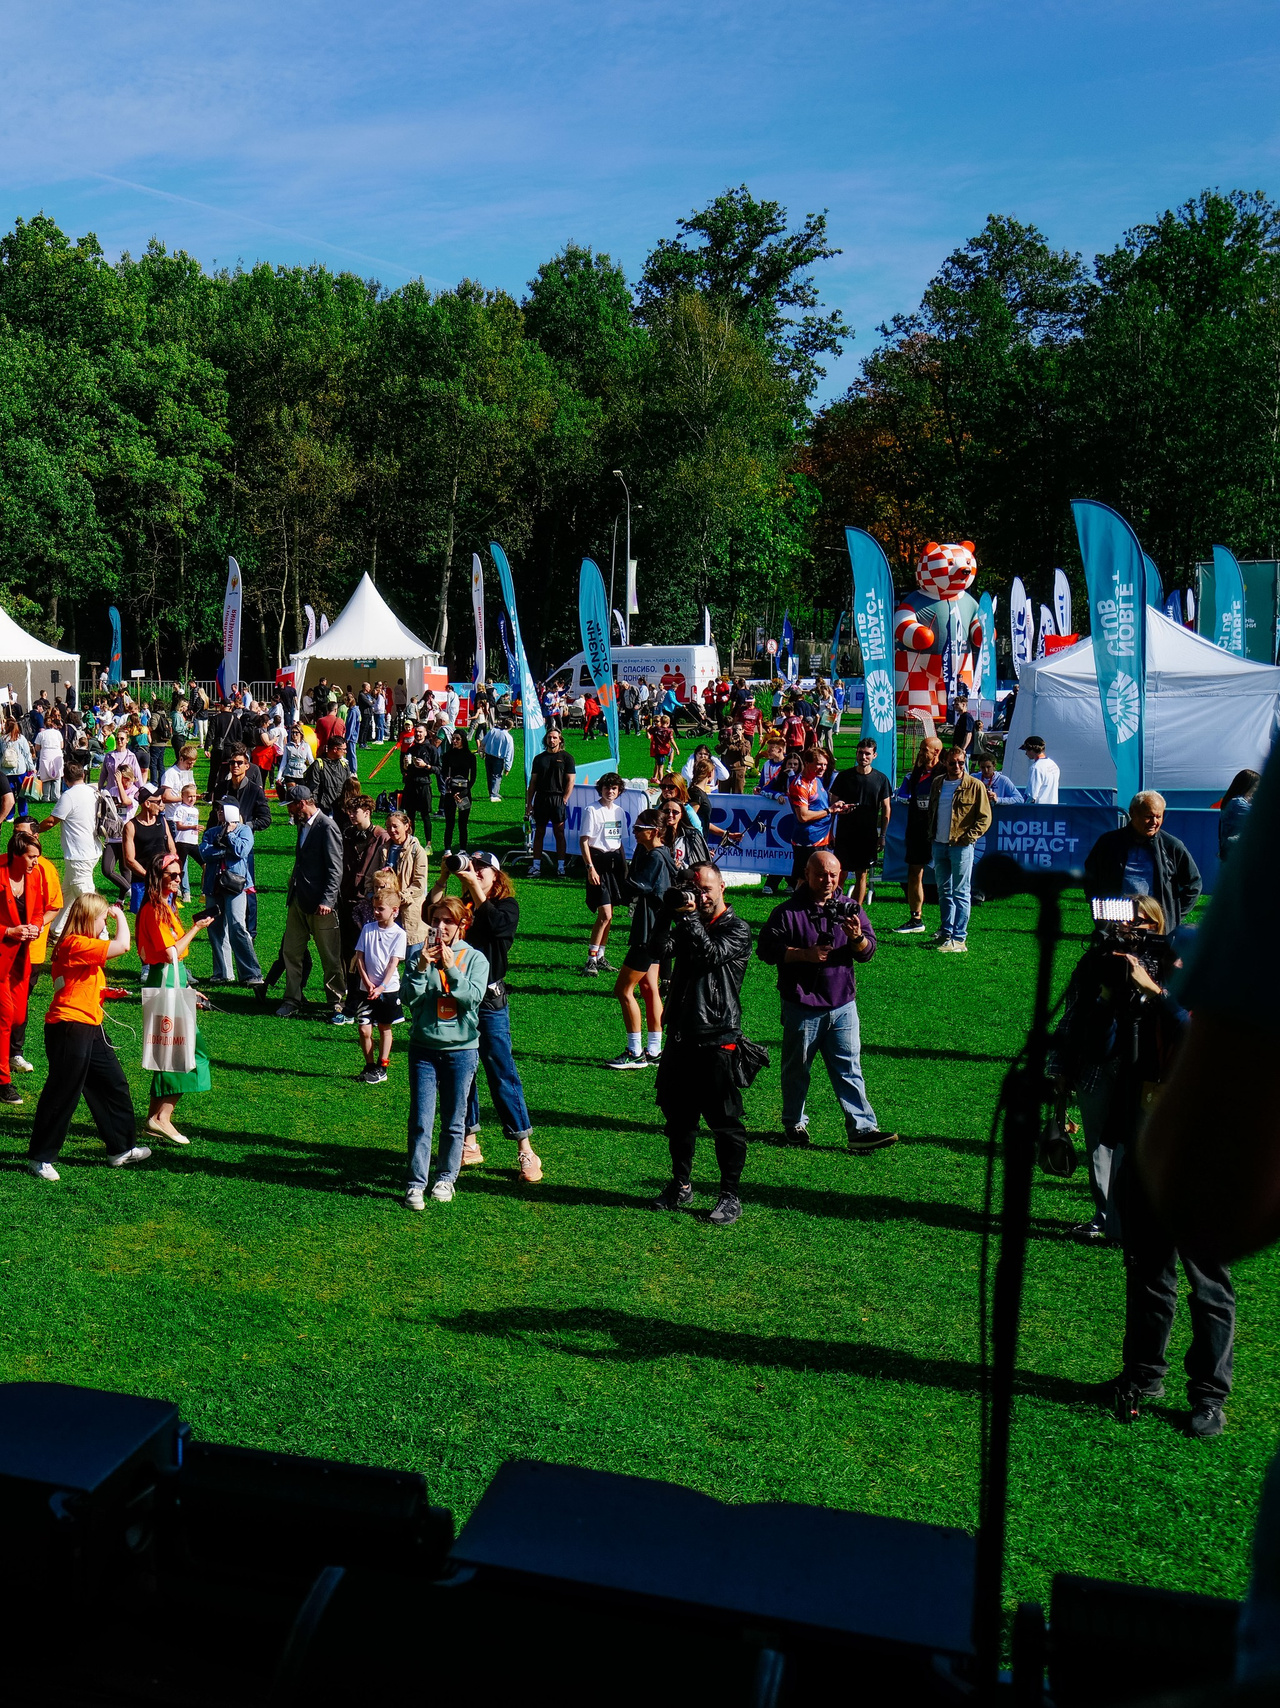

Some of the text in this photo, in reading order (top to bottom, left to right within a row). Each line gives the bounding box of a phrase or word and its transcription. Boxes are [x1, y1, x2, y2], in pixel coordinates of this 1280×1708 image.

[623, 665, 657, 673] СПАСИБО,
[997, 820, 1066, 836] NOBLE
[997, 836, 1079, 853] IMPACT
